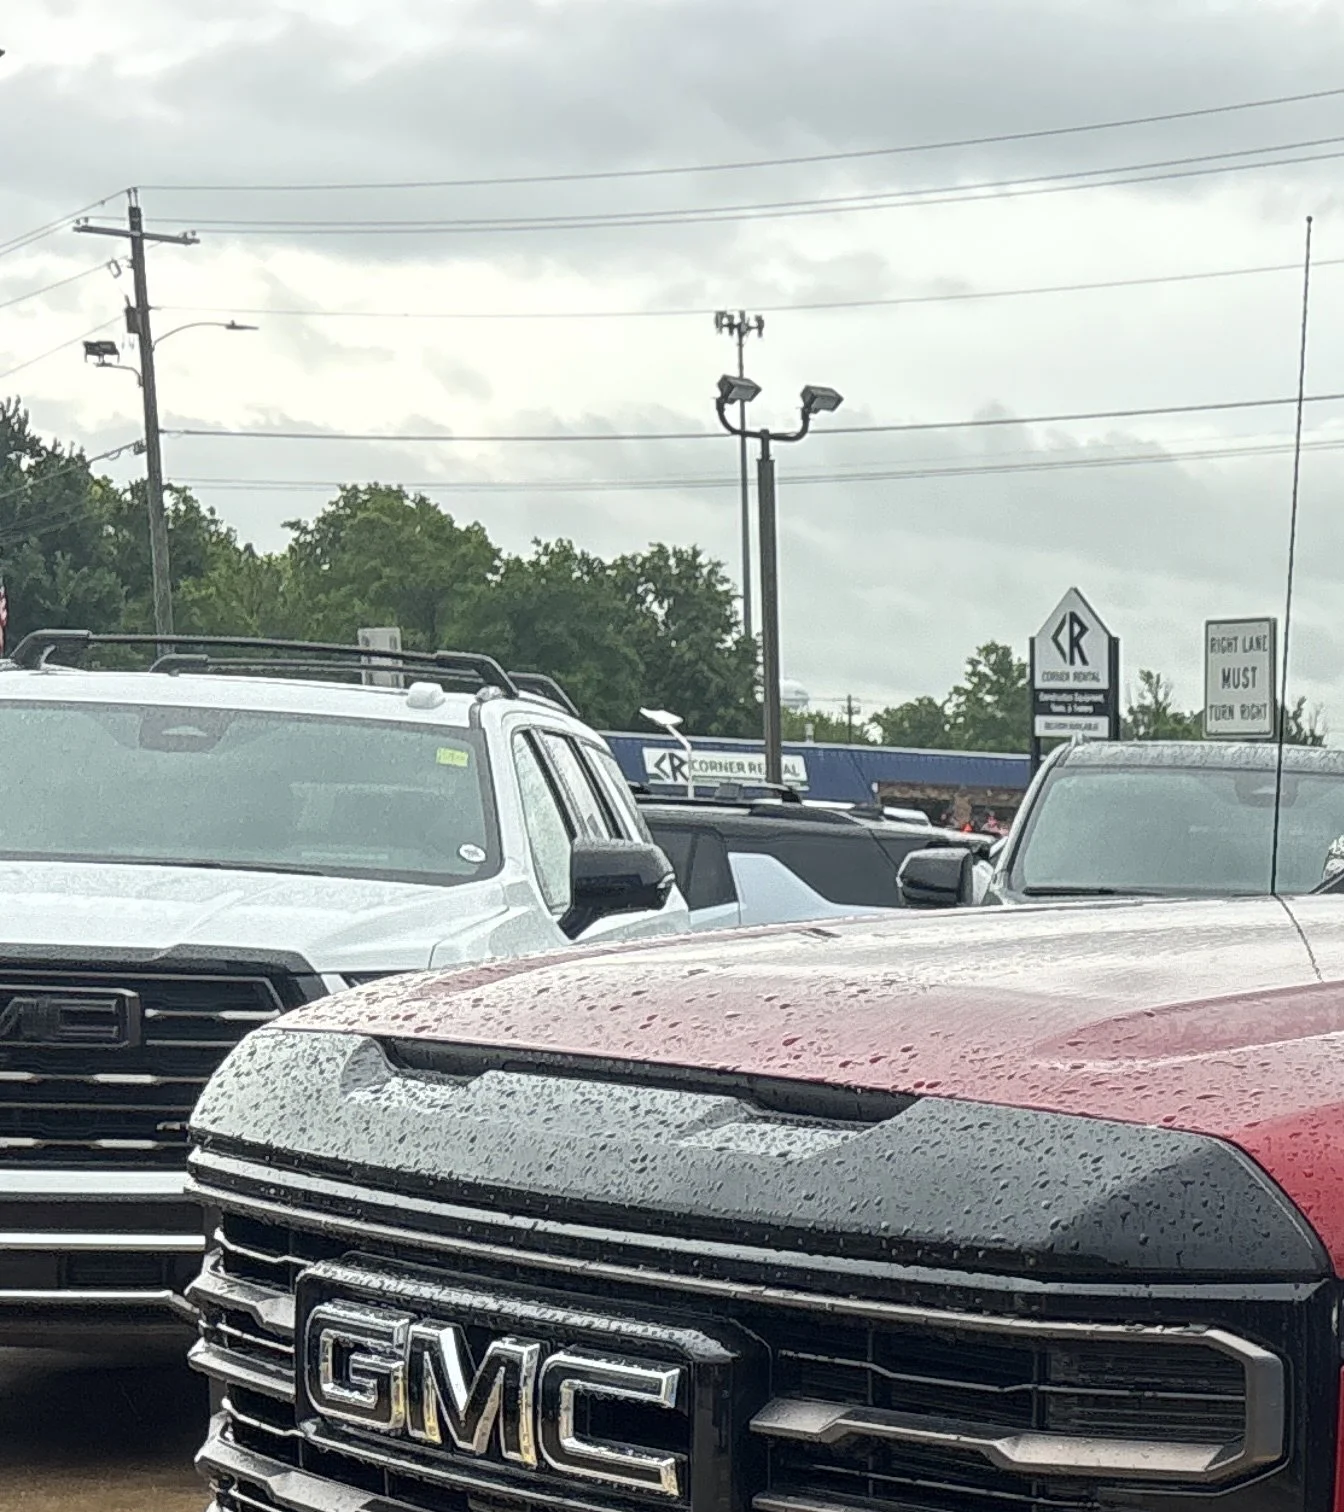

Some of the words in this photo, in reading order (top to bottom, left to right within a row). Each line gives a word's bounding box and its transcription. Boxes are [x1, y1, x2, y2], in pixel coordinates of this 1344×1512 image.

[1210, 636, 1238, 654] RIGHT
[1242, 635, 1268, 653] LANE
[1221, 666, 1257, 689] MUST
[1209, 704, 1234, 721] TURN
[1240, 703, 1267, 720] RIGHT
[690, 759, 746, 775] CORNER
[748, 761, 800, 777] REAL
[304, 1300, 681, 1496] GMC
